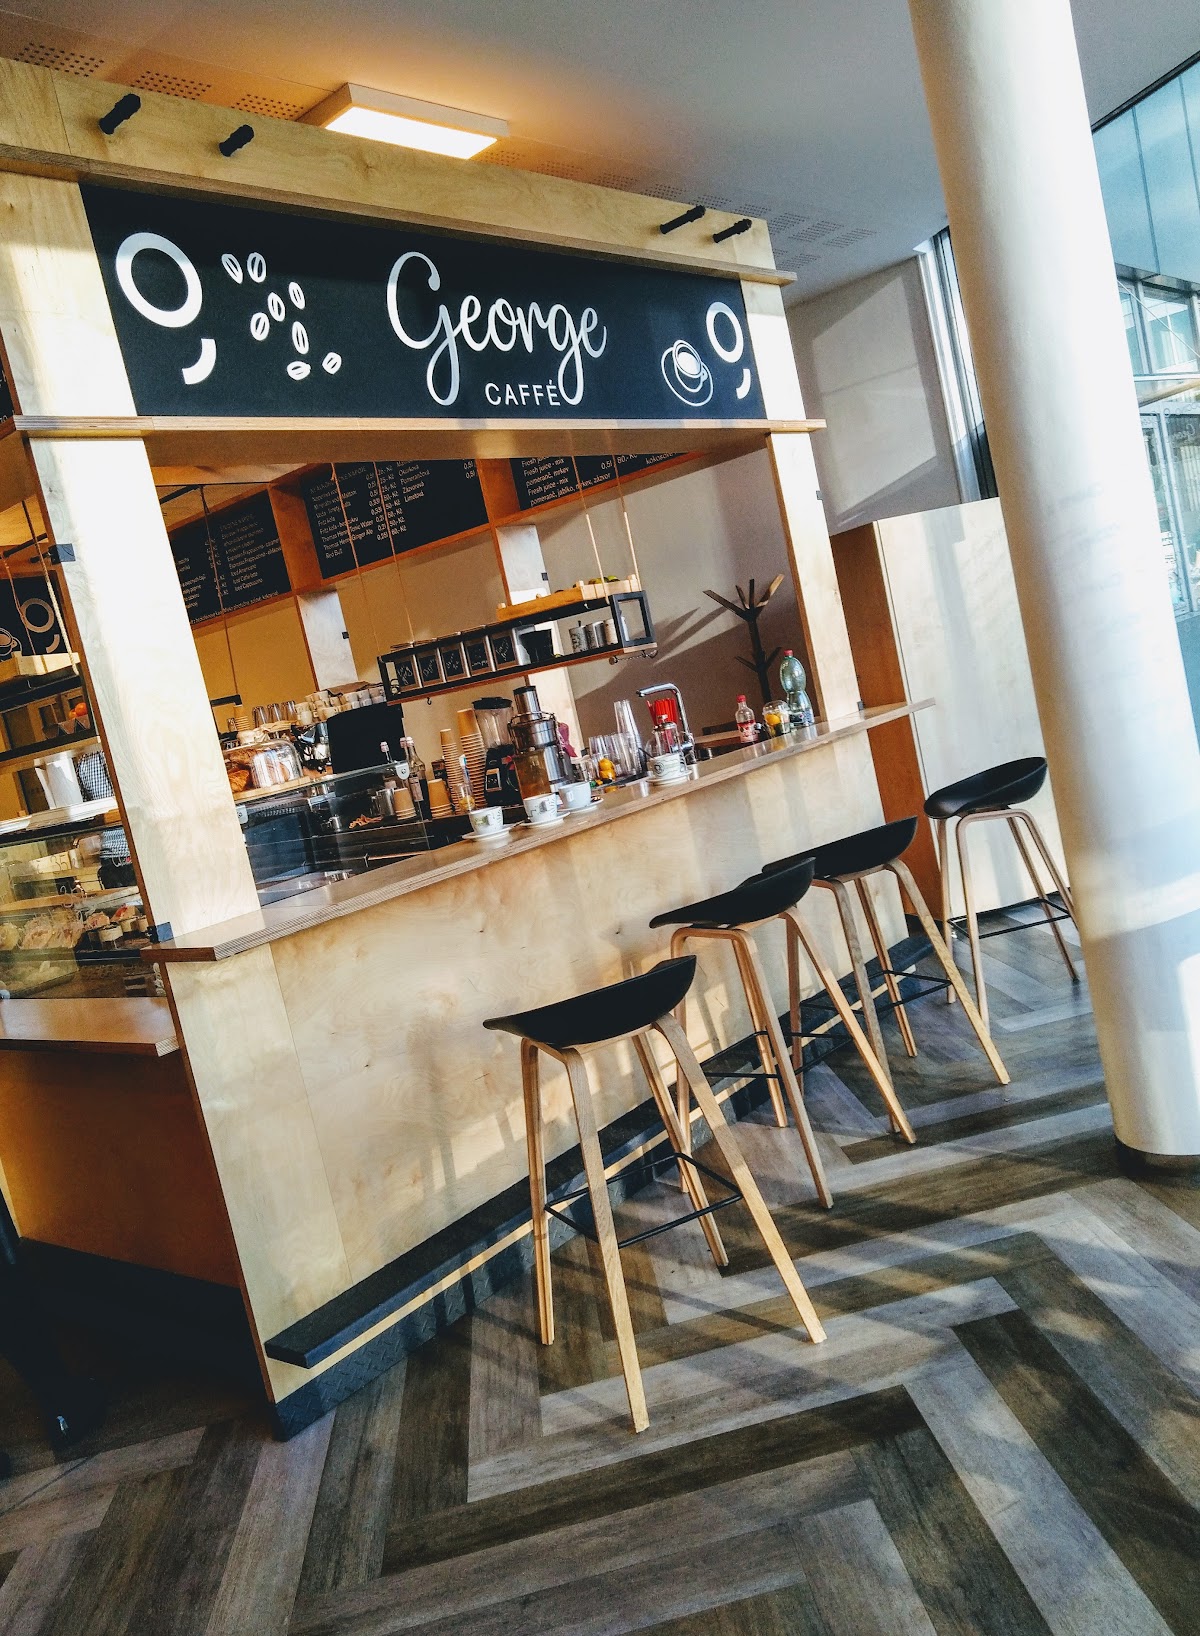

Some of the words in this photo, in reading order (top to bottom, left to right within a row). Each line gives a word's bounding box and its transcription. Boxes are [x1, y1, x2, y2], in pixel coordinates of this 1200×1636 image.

[387, 251, 607, 405] George
[485, 379, 560, 405] CAFFÉ
[522, 458, 536, 467] Fresh
[524, 467, 539, 476] Fresh
[539, 463, 552, 473] juice
[528, 486, 543, 496] Fresh
[543, 482, 556, 492] juice
[337, 529, 348, 537] Henr
[339, 537, 350, 545] Henr
